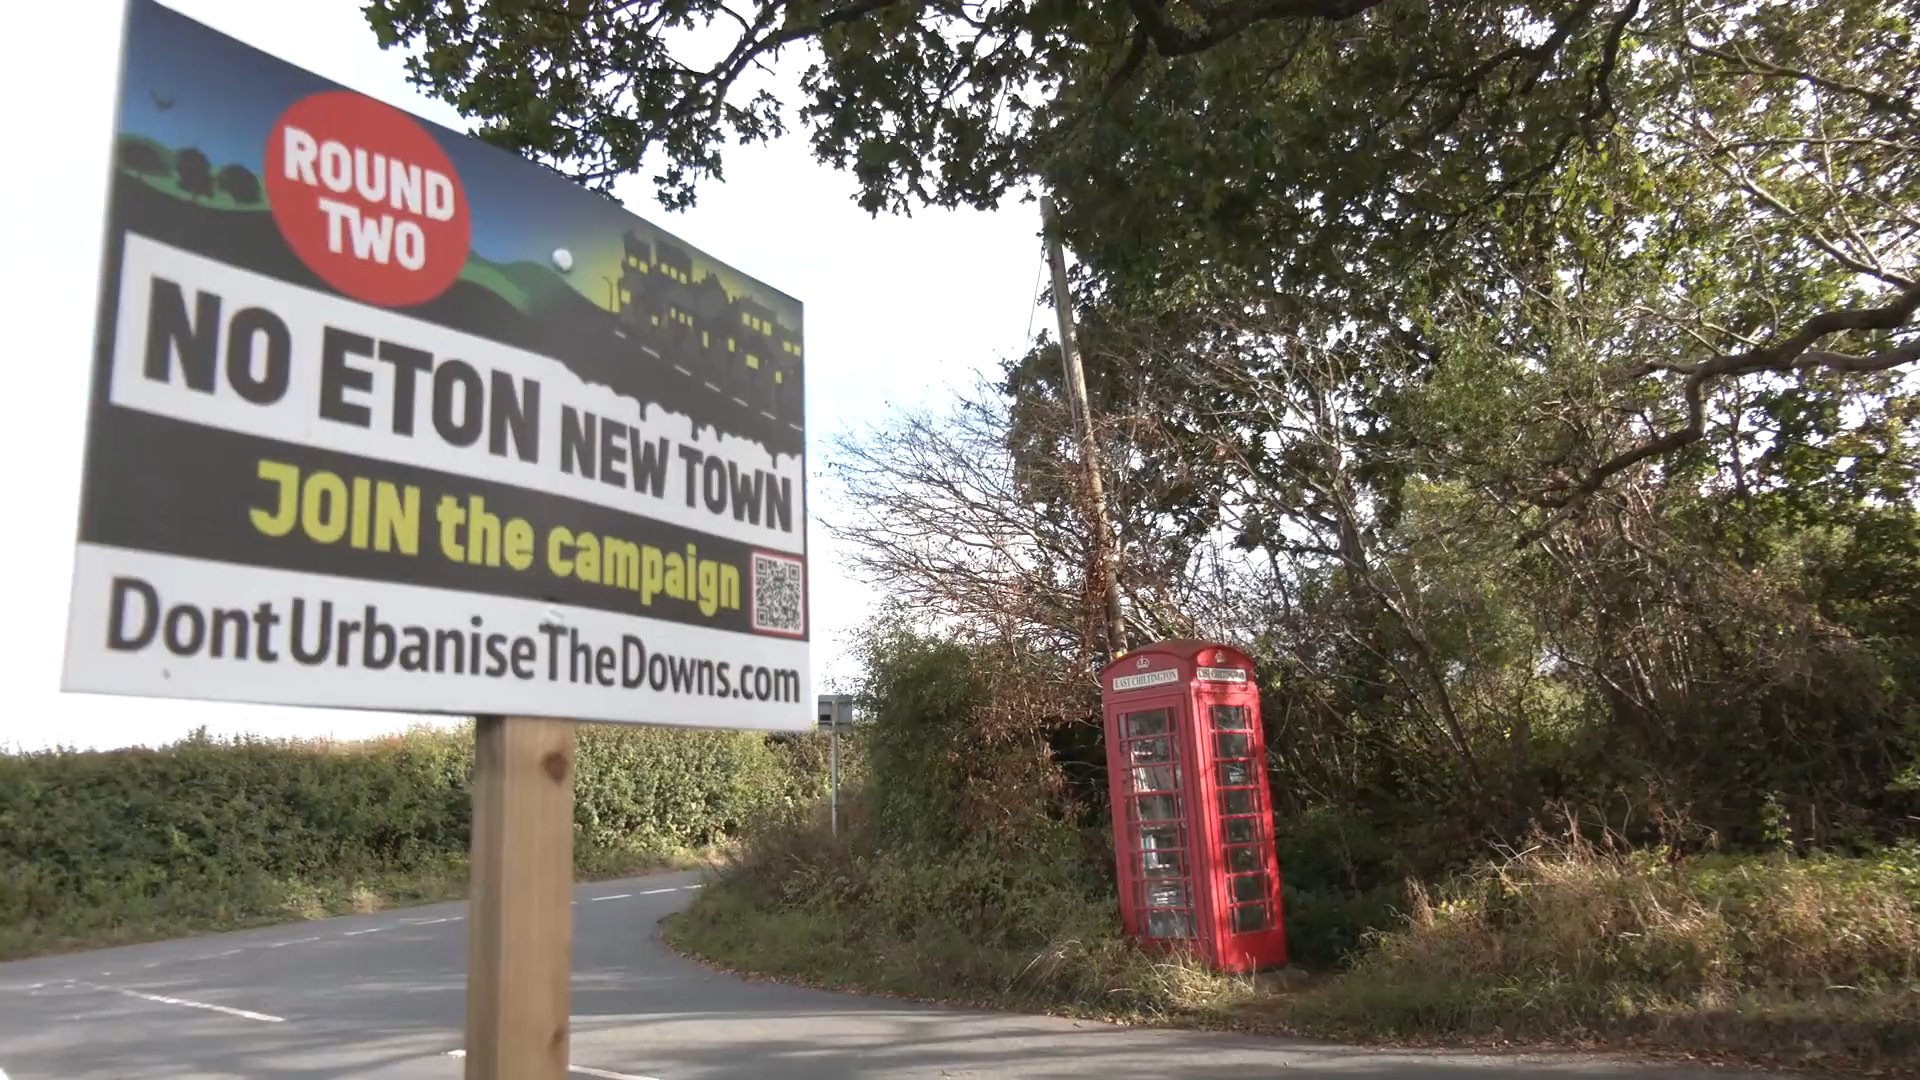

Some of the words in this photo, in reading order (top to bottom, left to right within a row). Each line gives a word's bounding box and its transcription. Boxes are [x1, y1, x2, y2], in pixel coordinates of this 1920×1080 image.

[283, 125, 455, 222] ROUND
[318, 197, 426, 271] TWO
[143, 273, 292, 406] NO
[318, 324, 540, 465] ETON
[560, 403, 669, 499] NEW
[678, 442, 793, 534] TOWN
[249, 458, 421, 556] JOIN
[436, 494, 535, 572] the
[547, 524, 741, 618] campaign
[105, 574, 801, 704] DontUrbaniseTheDowns.com
[1115, 678, 1131, 689] EAST
